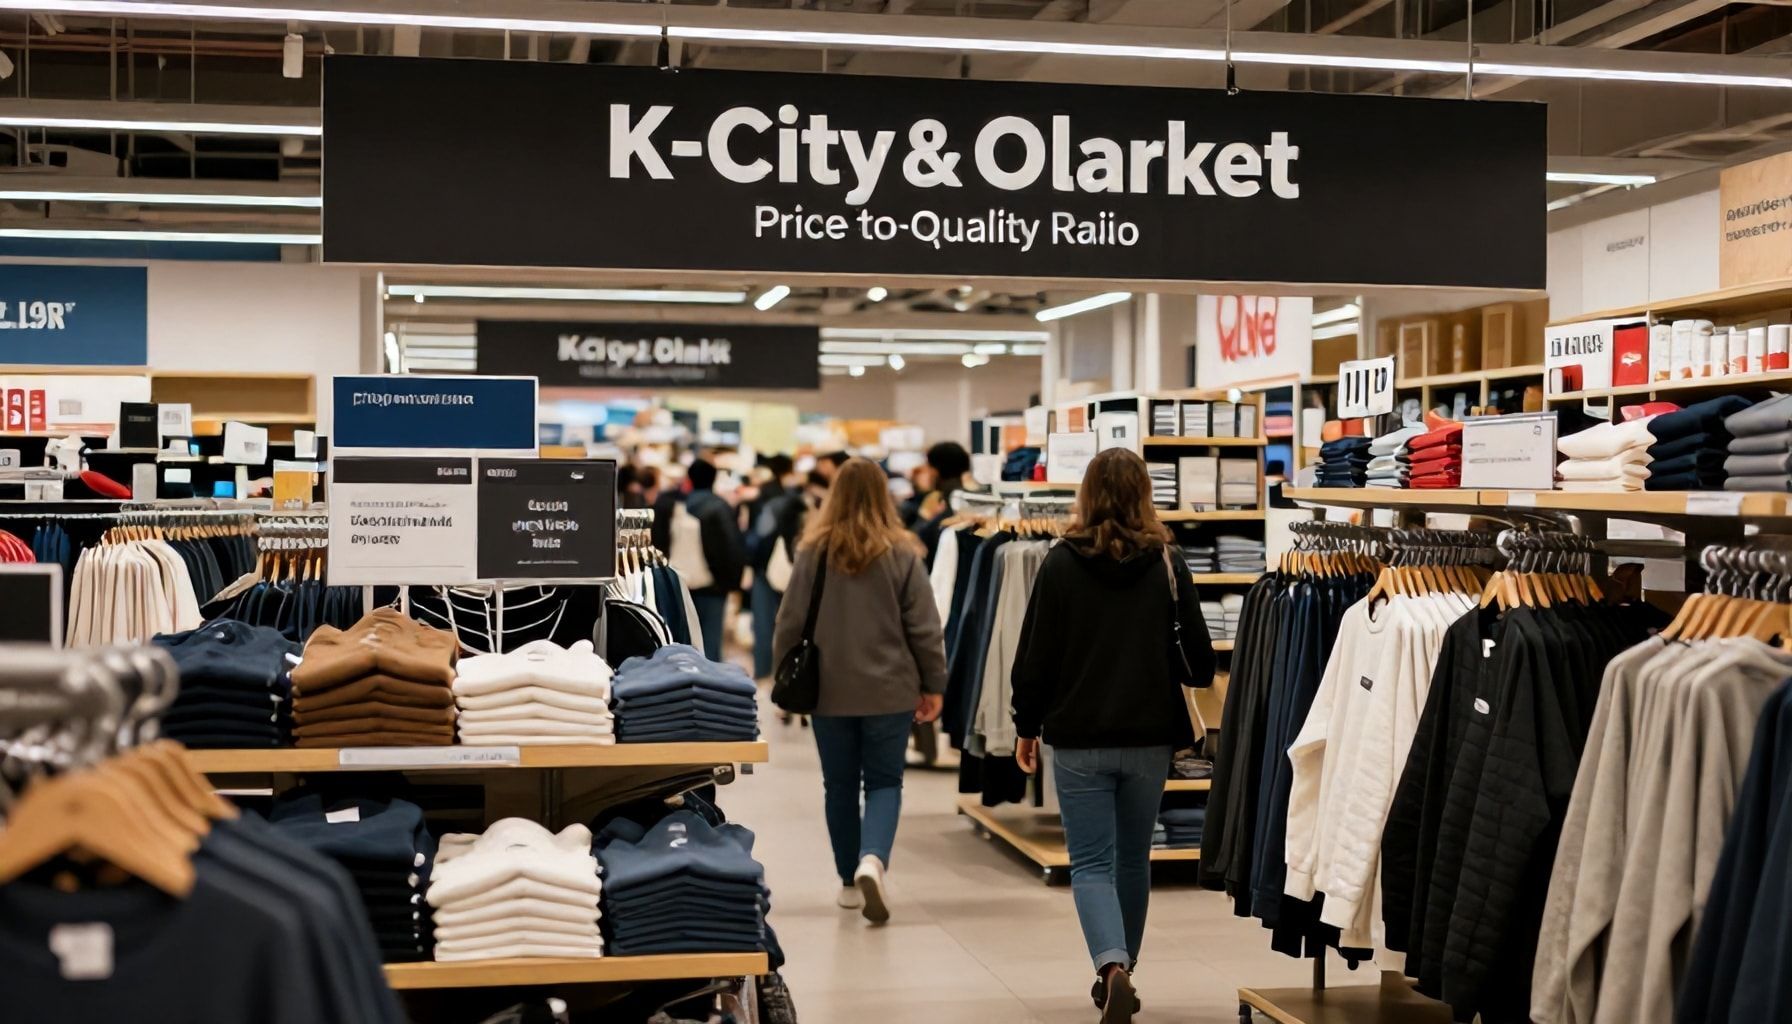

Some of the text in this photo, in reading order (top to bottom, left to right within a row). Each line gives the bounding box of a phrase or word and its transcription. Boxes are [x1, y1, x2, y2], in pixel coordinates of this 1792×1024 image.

[609, 103, 1300, 206] K-City & Olarket
[755, 204, 849, 240] Price
[856, 208, 1041, 252] to-Quality
